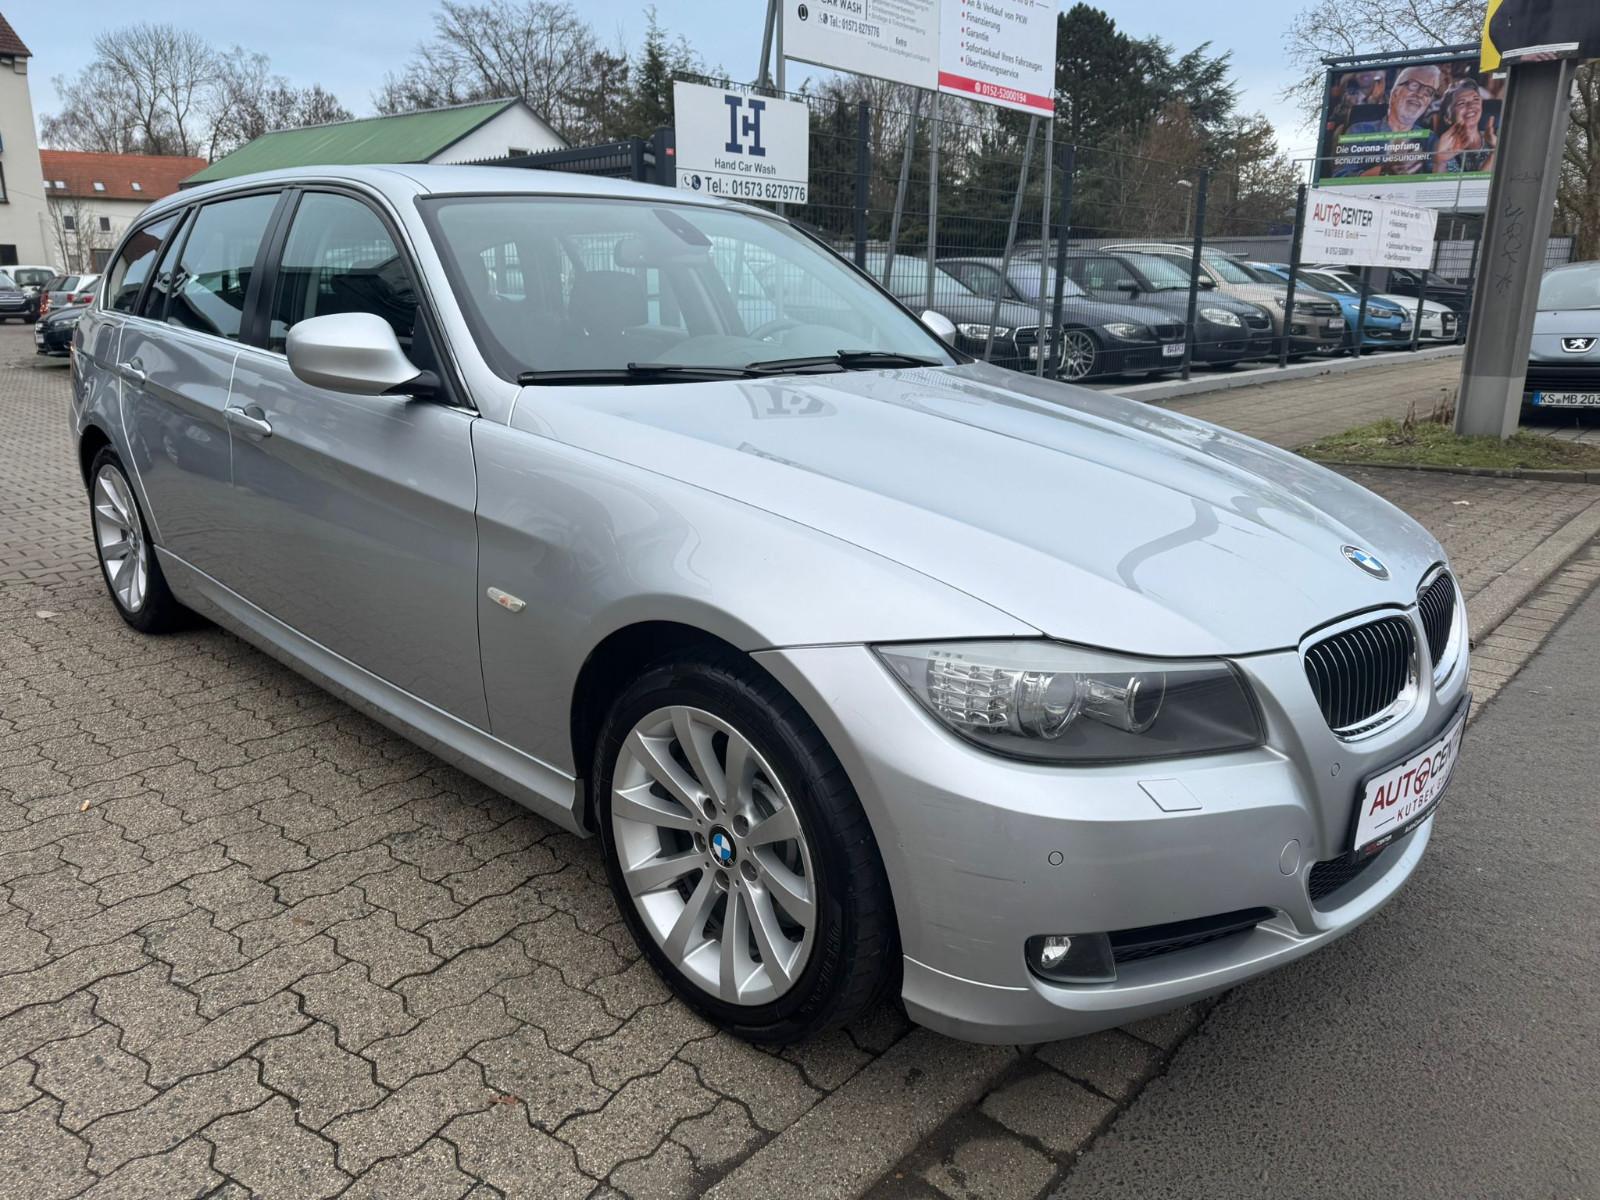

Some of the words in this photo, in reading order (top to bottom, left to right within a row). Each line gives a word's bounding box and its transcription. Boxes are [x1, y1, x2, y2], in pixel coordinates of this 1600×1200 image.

[840, 0, 862, 14] WASH
[983, 3, 1003, 17] Verkauf
[1004, 10, 1015, 21] von
[1015, 13, 1028, 25] PKW
[841, 18, 858, 33] 01573
[966, 11, 1001, 33] Finanzierung
[966, 26, 989, 42] Garantie
[965, 41, 1001, 60] Sofortankauf
[1001, 51, 1014, 64] Ihres
[1015, 55, 1043, 72] Fahrzeuges
[965, 54, 1019, 79] Überführungsservice
[1335, 145, 1349, 154] Die
[1350, 142, 1420, 153] Corona-Impfung
[714, 157, 736, 170] Hand
[738, 160, 753, 173] Car
[754, 162, 776, 175] Wash
[705, 176, 728, 194] Tel.:
[732, 180, 763, 197] 01573
[765, 183, 806, 201] 6279776
[1313, 202, 1373, 227] AUTOCENTER
[1541, 394, 1556, 403] KS
[1562, 394, 1578, 404] MB
